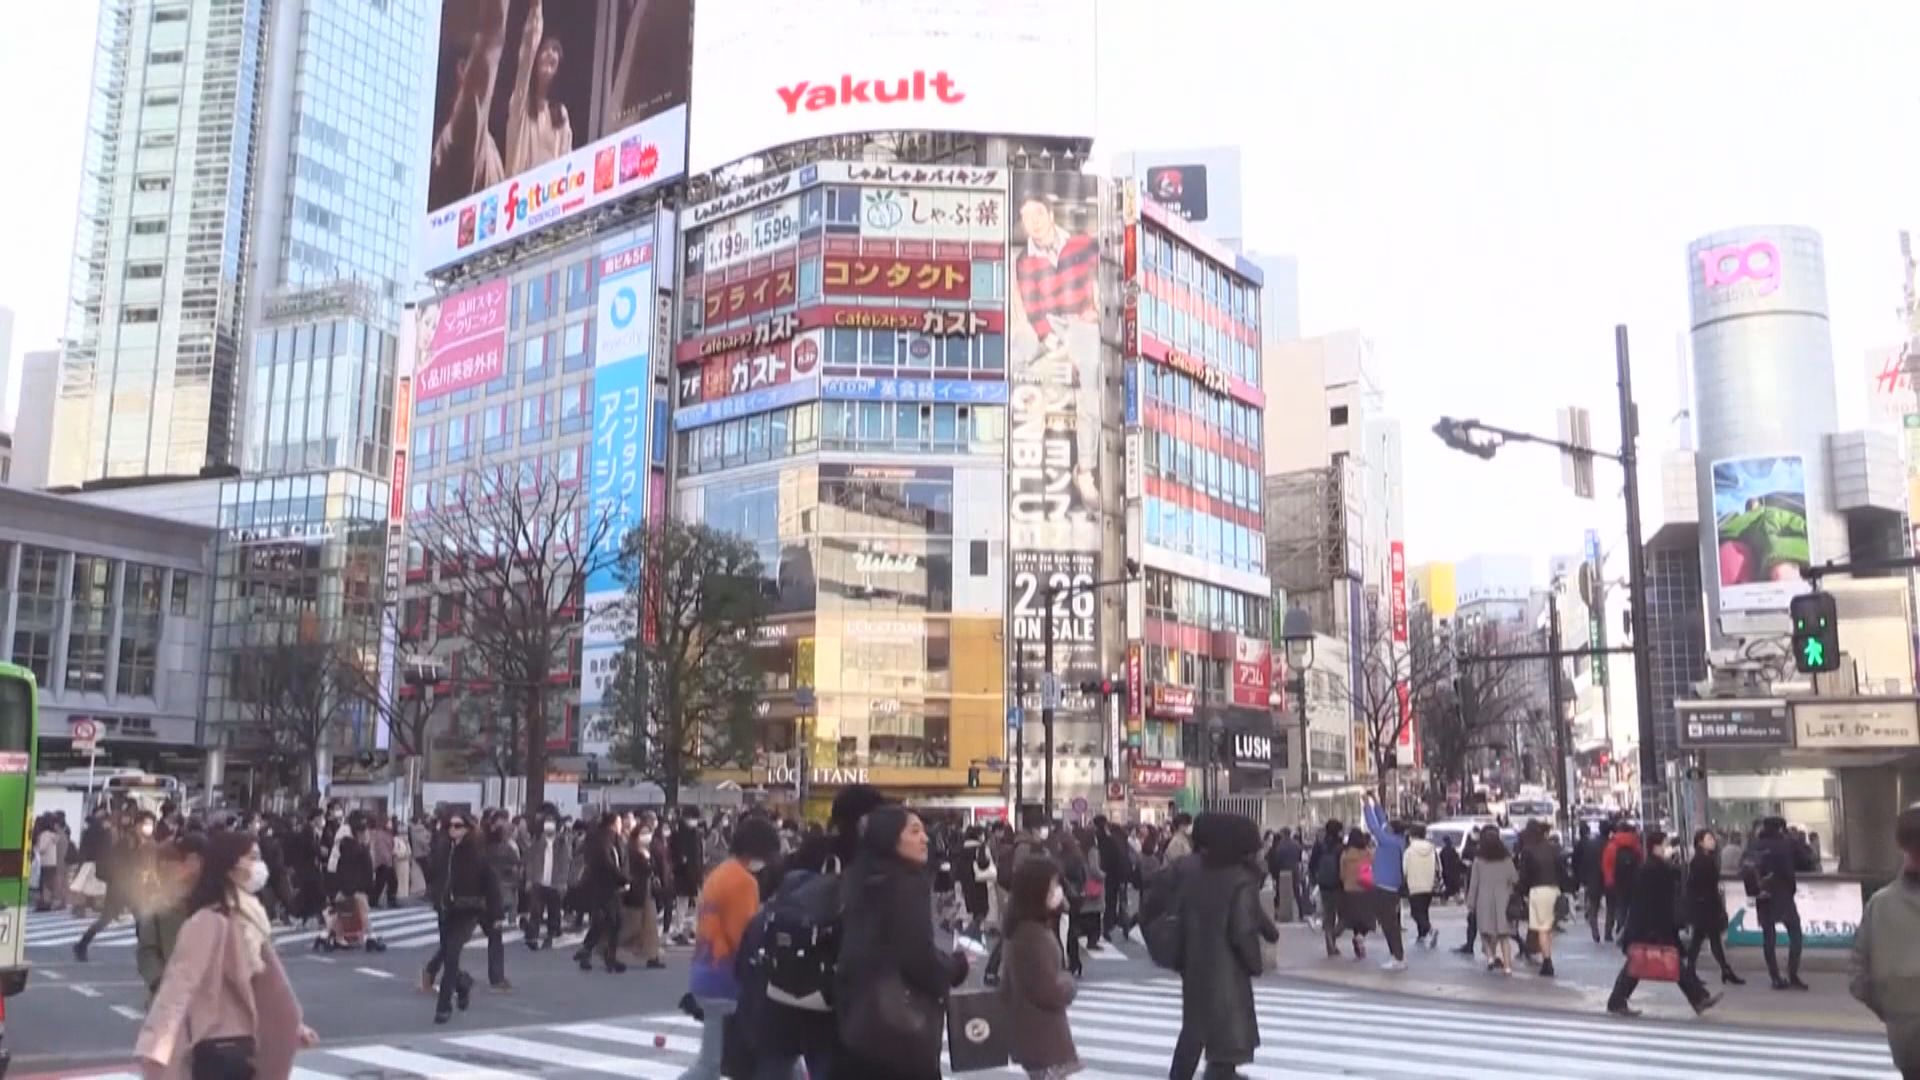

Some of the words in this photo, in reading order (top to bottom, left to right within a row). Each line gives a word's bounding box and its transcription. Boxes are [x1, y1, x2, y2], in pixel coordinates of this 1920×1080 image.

[776, 70, 966, 115] Yakult
[911, 197, 1000, 227] しゃぶ葉
[688, 242, 704, 263] 9F
[823, 259, 967, 291] コンタクト
[457, 288, 503, 316] 品川スキン
[456, 310, 497, 337] クリニック
[754, 312, 800, 346] ガスト
[923, 308, 988, 336] ガスト
[427, 350, 499, 390] 品川美容外科
[730, 352, 787, 394] ガスト
[682, 374, 701, 399] 7F
[1014, 552, 1038, 564] JAPAN
[1013, 572, 1096, 618] 2.26
[1014, 617, 1042, 640] ON
[1051, 617, 1096, 642] SALE
[1239, 664, 1264, 686] アコム
[1234, 733, 1272, 760] LUSH
[767, 764, 870, 784] L'OCITANE
